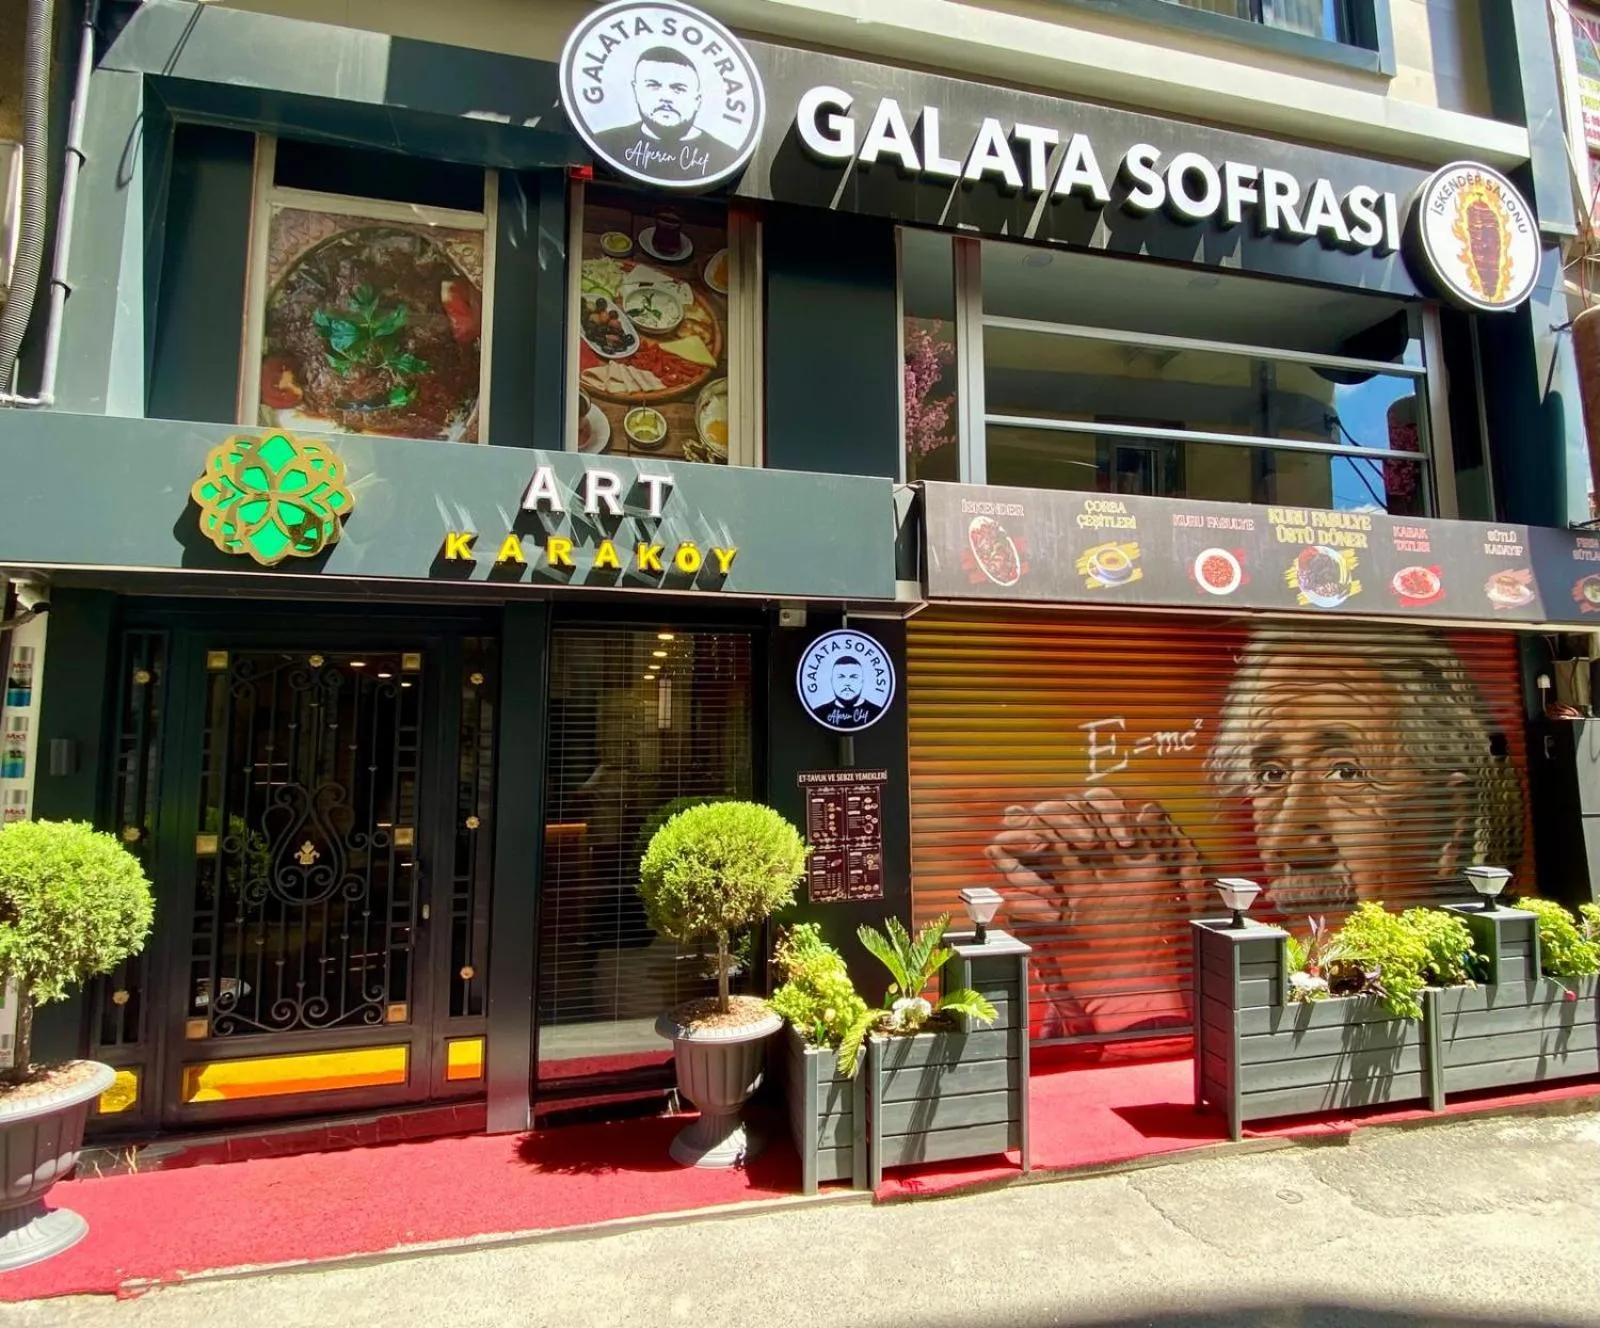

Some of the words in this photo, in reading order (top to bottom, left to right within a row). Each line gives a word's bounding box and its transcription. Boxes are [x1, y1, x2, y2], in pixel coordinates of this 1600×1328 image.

[582, 17, 653, 104] GALATA
[661, 17, 746, 125] SOFRASI
[625, 140, 676, 169] Alperen
[680, 146, 709, 175] Chef
[797, 86, 1110, 200] GALATA
[1123, 143, 1399, 250] SOFRASI
[1485, 179, 1528, 234] SALONU
[522, 466, 673, 517] ART
[1084, 499, 1127, 514] ÇORBA
[1268, 508, 1308, 526] KURU
[1311, 511, 1371, 531] FASULYE
[1317, 528, 1367, 548] DÖNER
[445, 532, 737, 574] KARAKÖY
[807, 640, 841, 693] GALATA
[844, 639, 886, 693] SOFRASI
